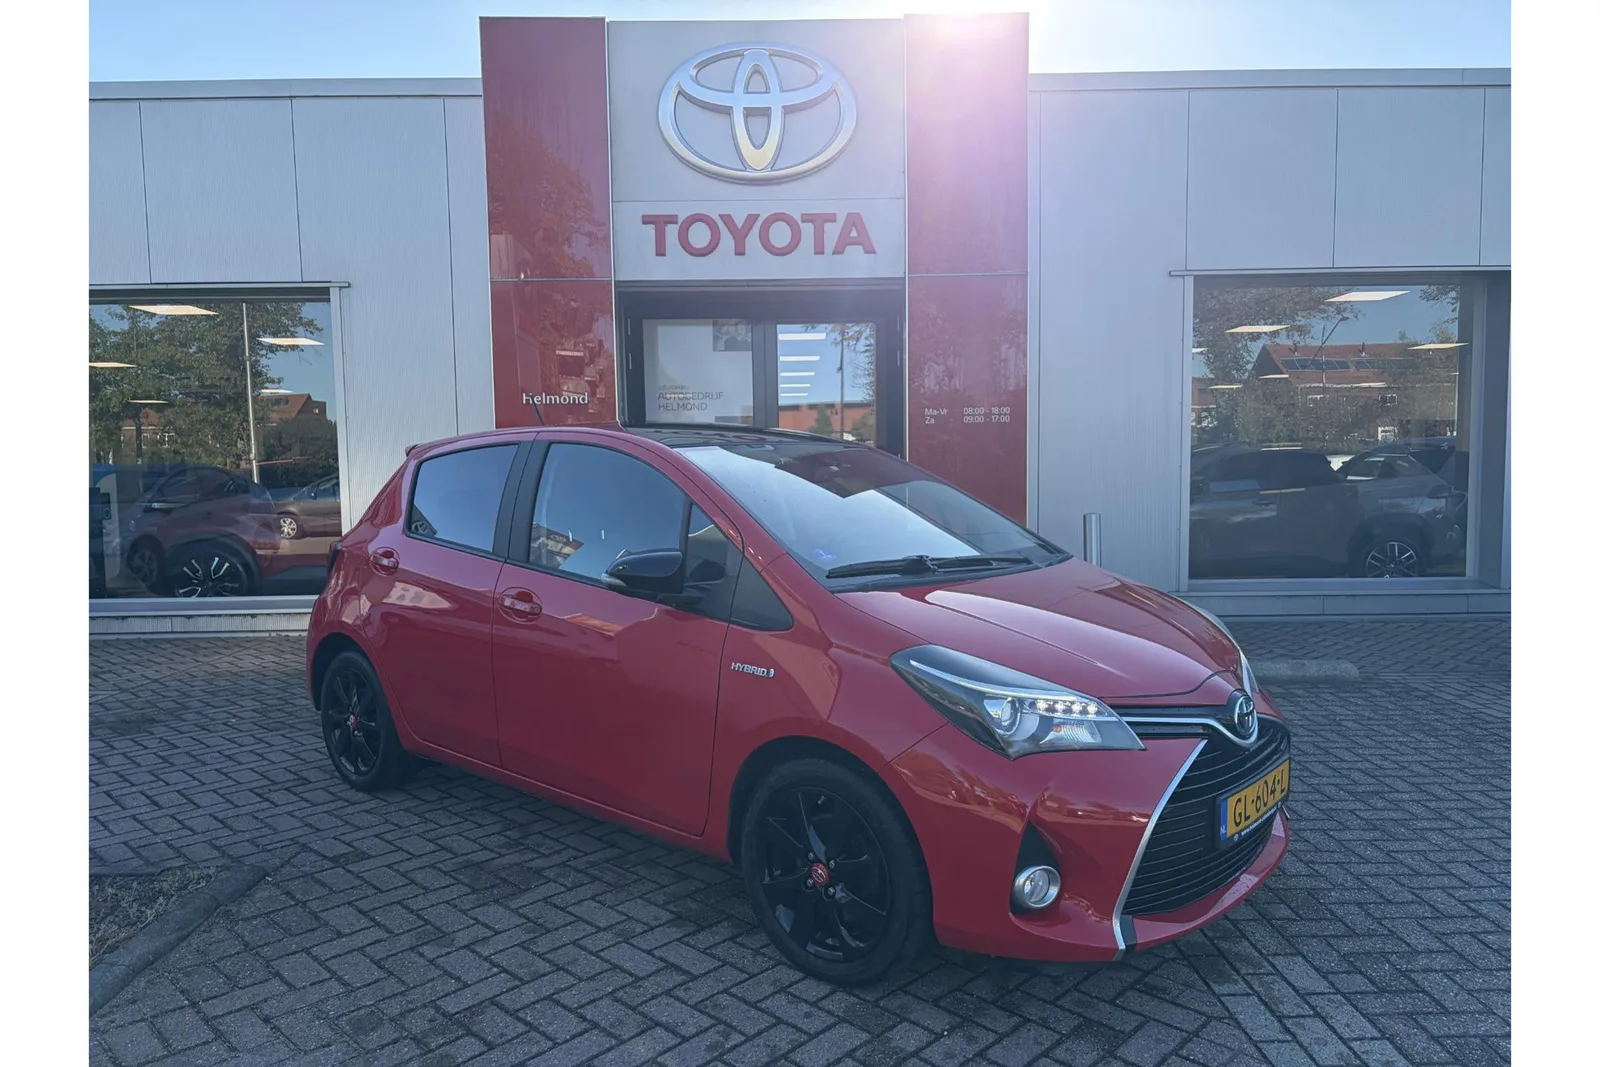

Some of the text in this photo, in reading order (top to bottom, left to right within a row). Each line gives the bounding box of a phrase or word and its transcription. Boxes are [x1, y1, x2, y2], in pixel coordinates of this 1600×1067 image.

[641, 212, 877, 257] TOYOTA
[522, 392, 588, 404] Helmond
[658, 402, 708, 412] HELMOND
[925, 408, 948, 416] Ma-Vr
[963, 407, 985, 415] 08:00
[925, 417, 935, 425] Za
[991, 415, 1010, 423] 17:00
[731, 662, 767, 677] HYBRID
[1233, 768, 1286, 828] GL-604-L
